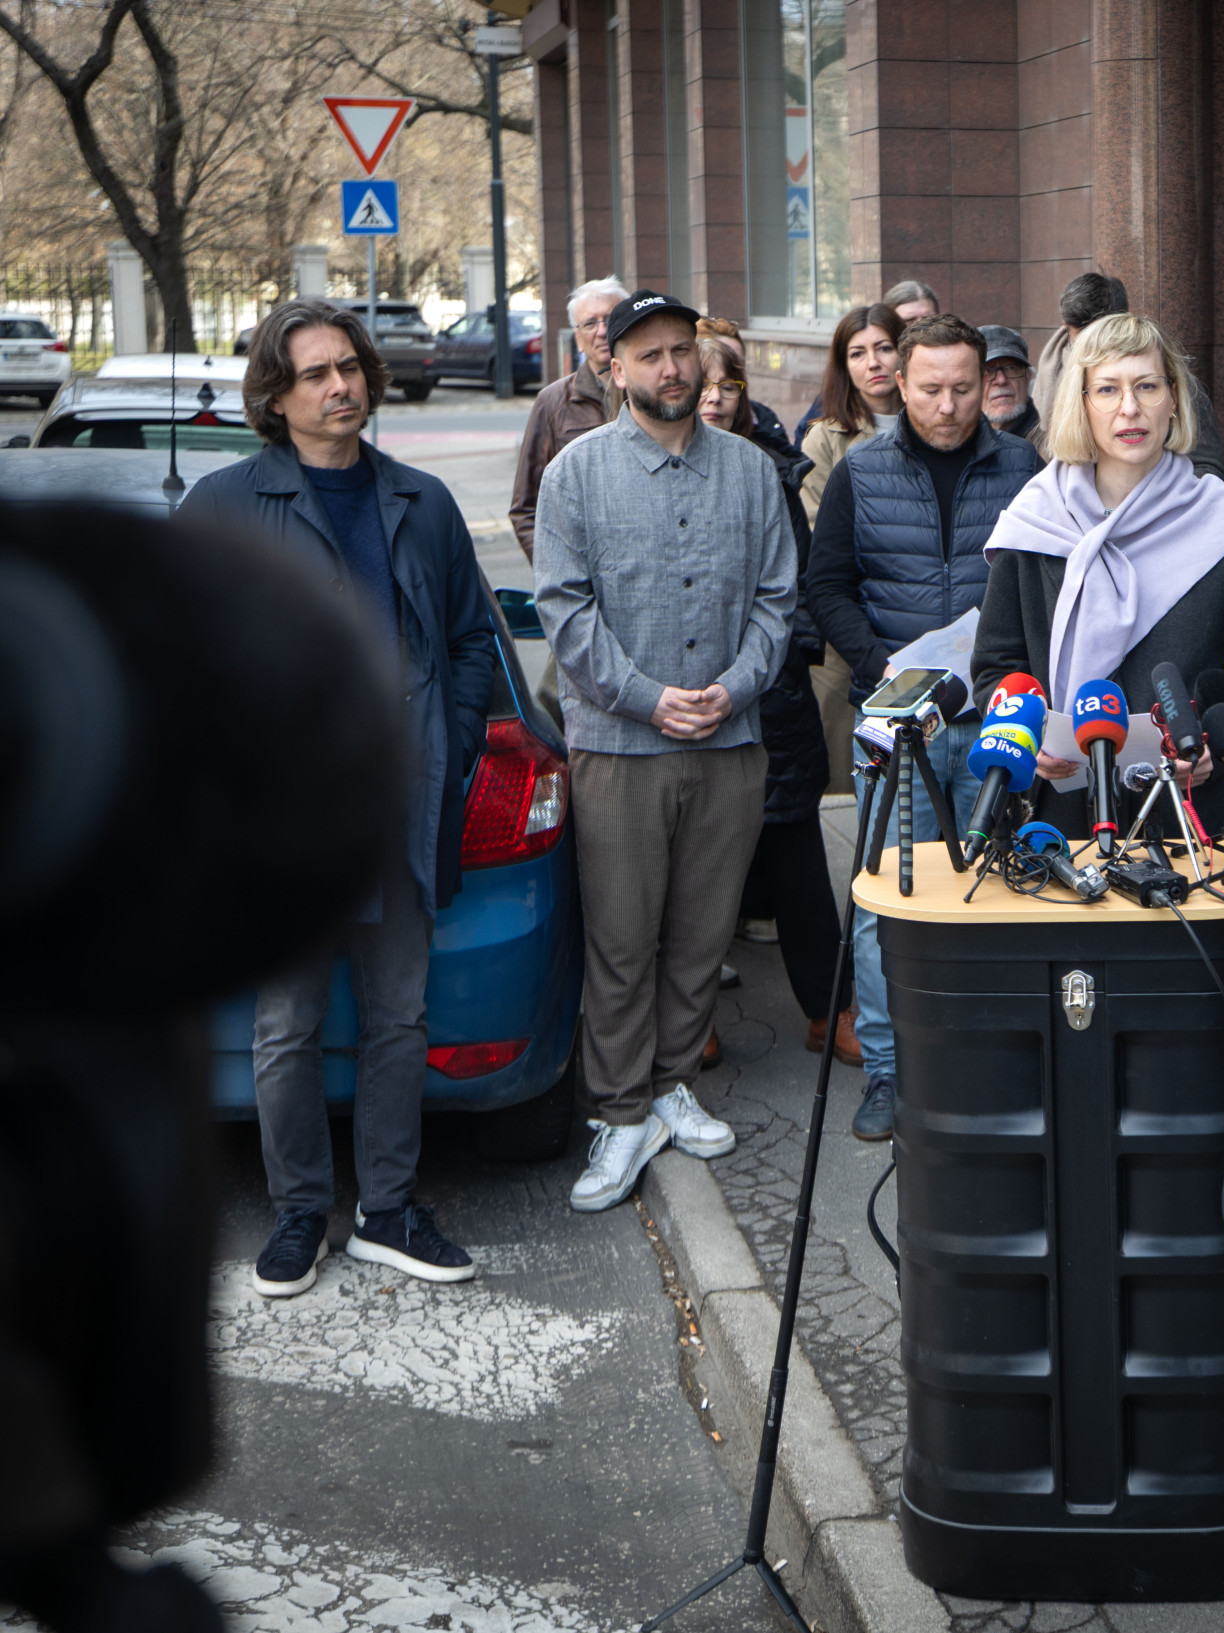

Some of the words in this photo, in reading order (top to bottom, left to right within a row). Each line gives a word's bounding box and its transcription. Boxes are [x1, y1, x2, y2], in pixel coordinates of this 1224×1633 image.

[633, 296, 666, 310] DONE
[1075, 693, 1121, 715] ta3
[997, 739, 1022, 758] live
